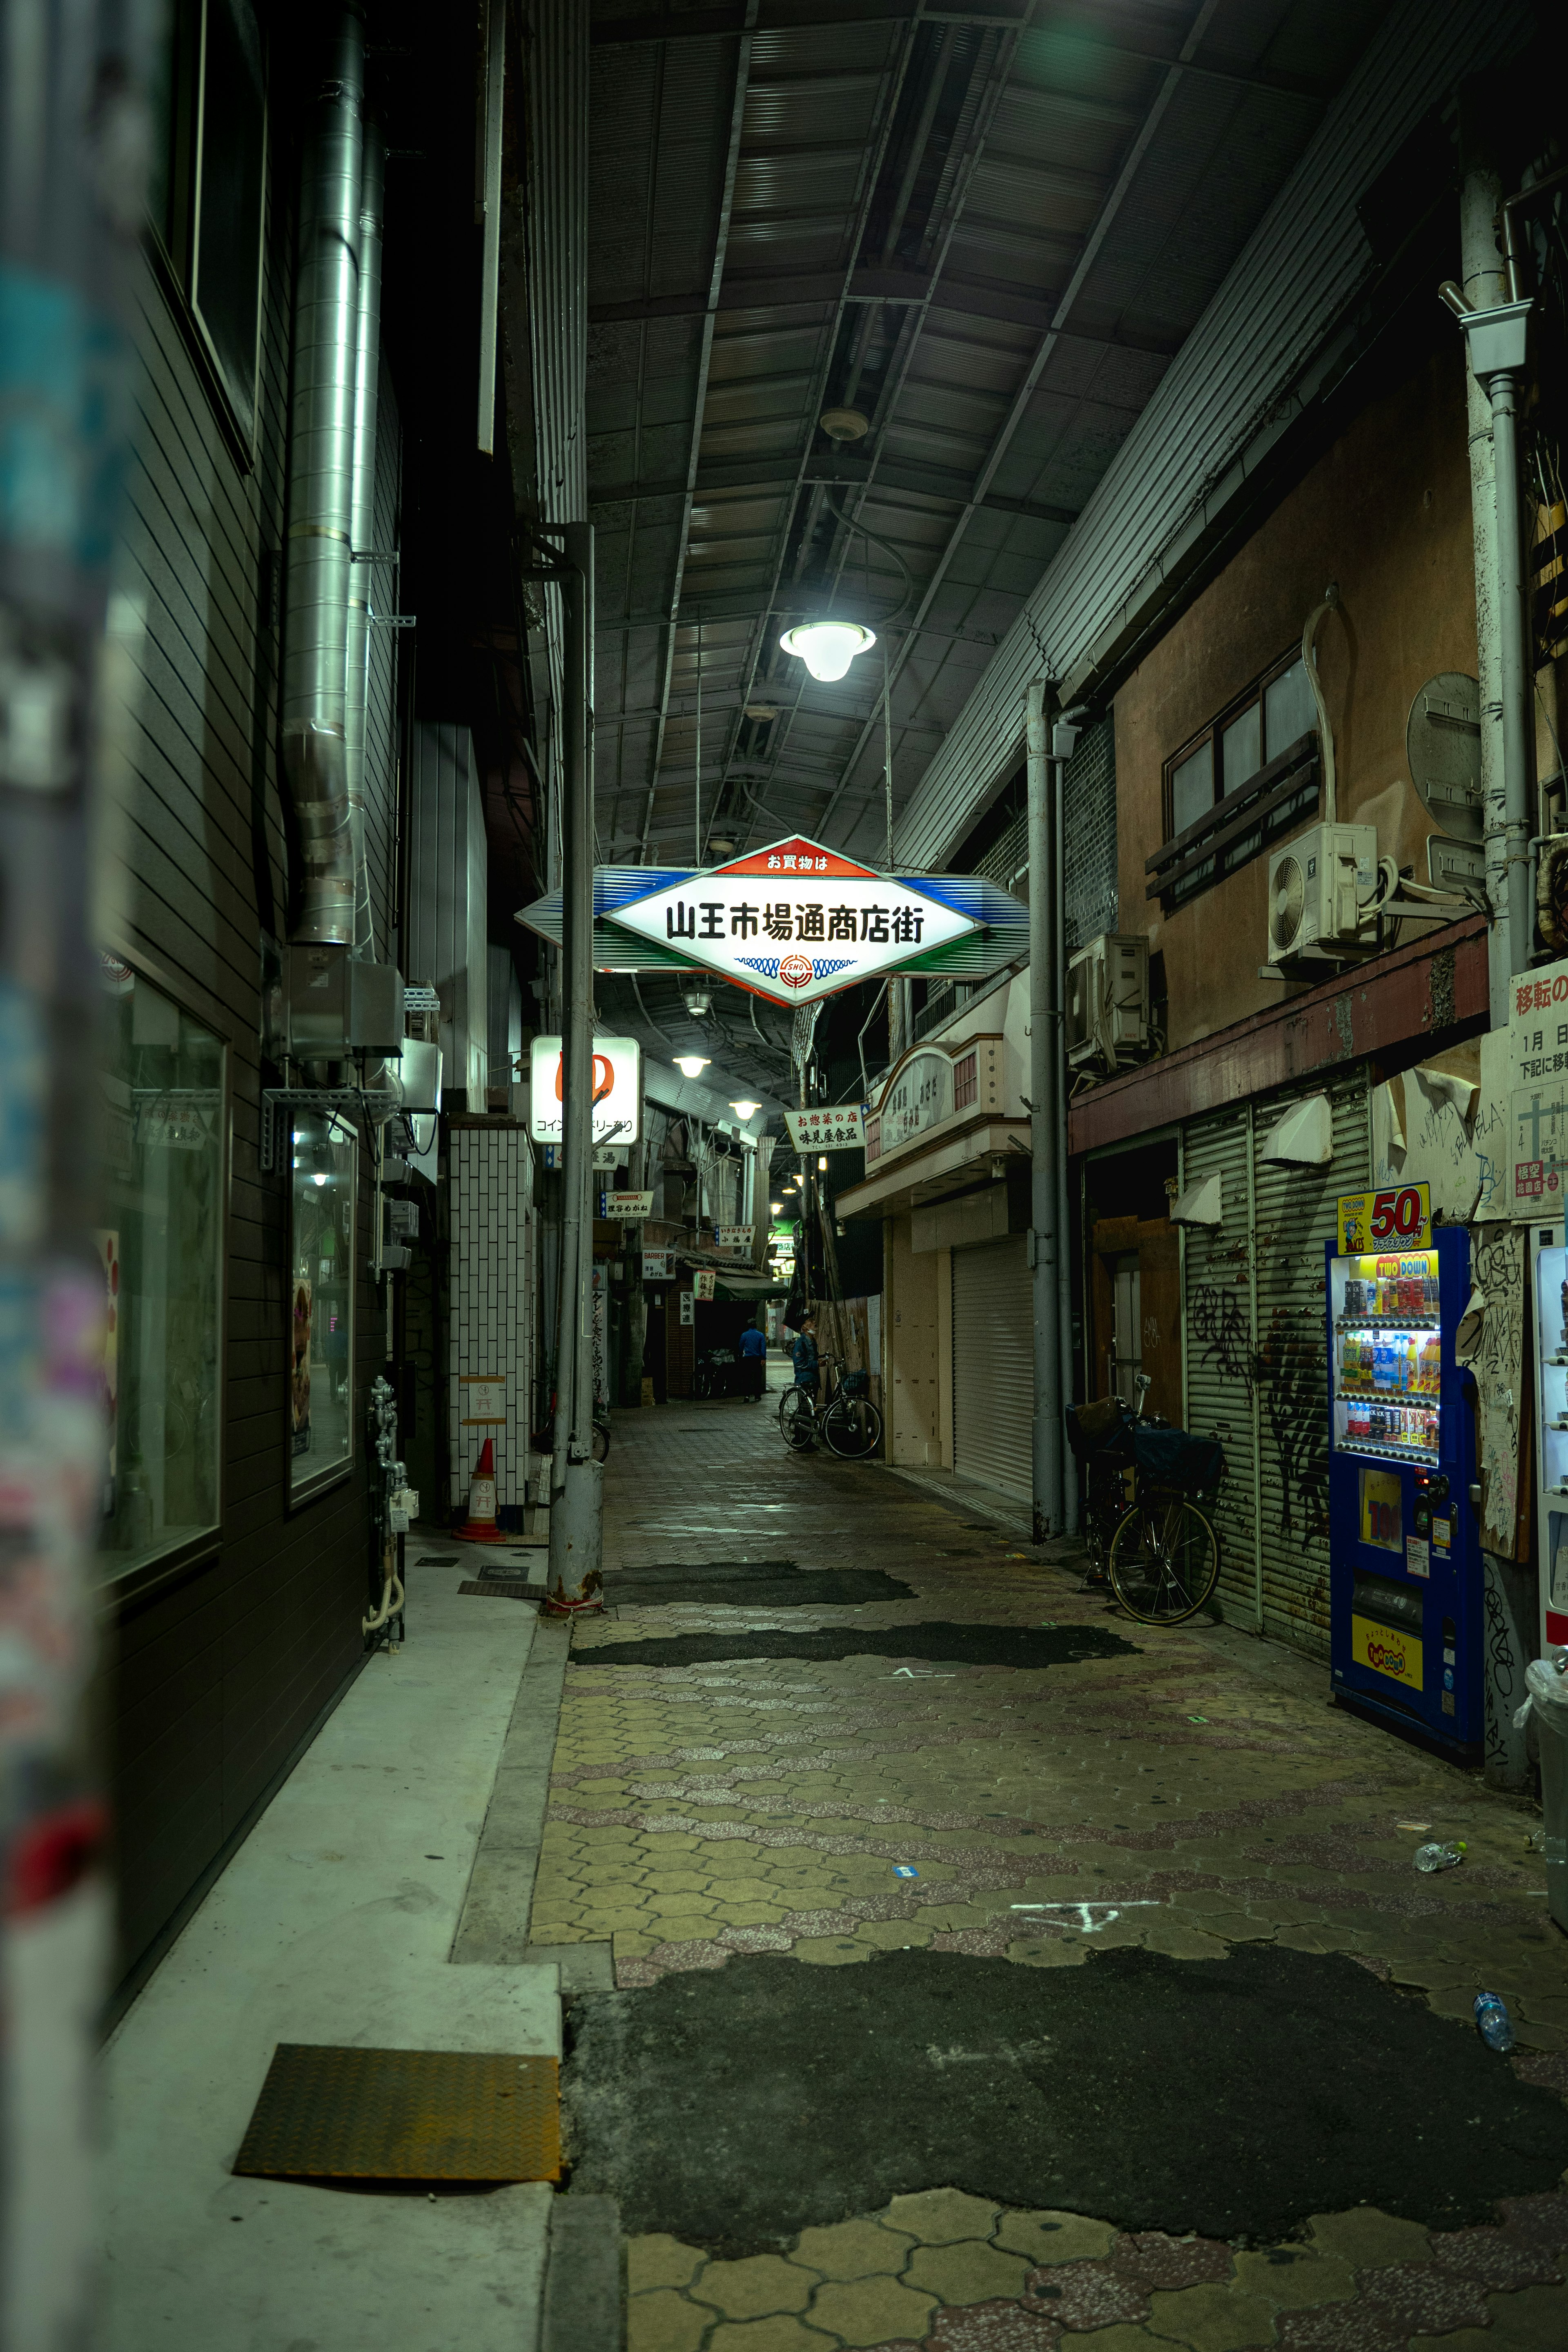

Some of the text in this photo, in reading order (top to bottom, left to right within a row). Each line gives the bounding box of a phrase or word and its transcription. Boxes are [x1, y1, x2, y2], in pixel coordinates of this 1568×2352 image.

[767, 855, 828, 871] お買物は
[667, 901, 924, 943] 山王市場通商店街
[1516, 975, 1568, 1016] 移転の
[798, 1111, 858, 1127] お惣菜の店
[799, 1127, 858, 1145] 味見屋食品
[1518, 1163, 1540, 1180] 悟空
[1517, 1180, 1541, 1195] 花園店
[1343, 1200, 1364, 1211] TWO DOWN
[1373, 1236, 1413, 1250] プライスダウン
[1379, 1261, 1427, 1276] TWO DOWN
[1370, 1647, 1403, 1670] TWO DOWN
